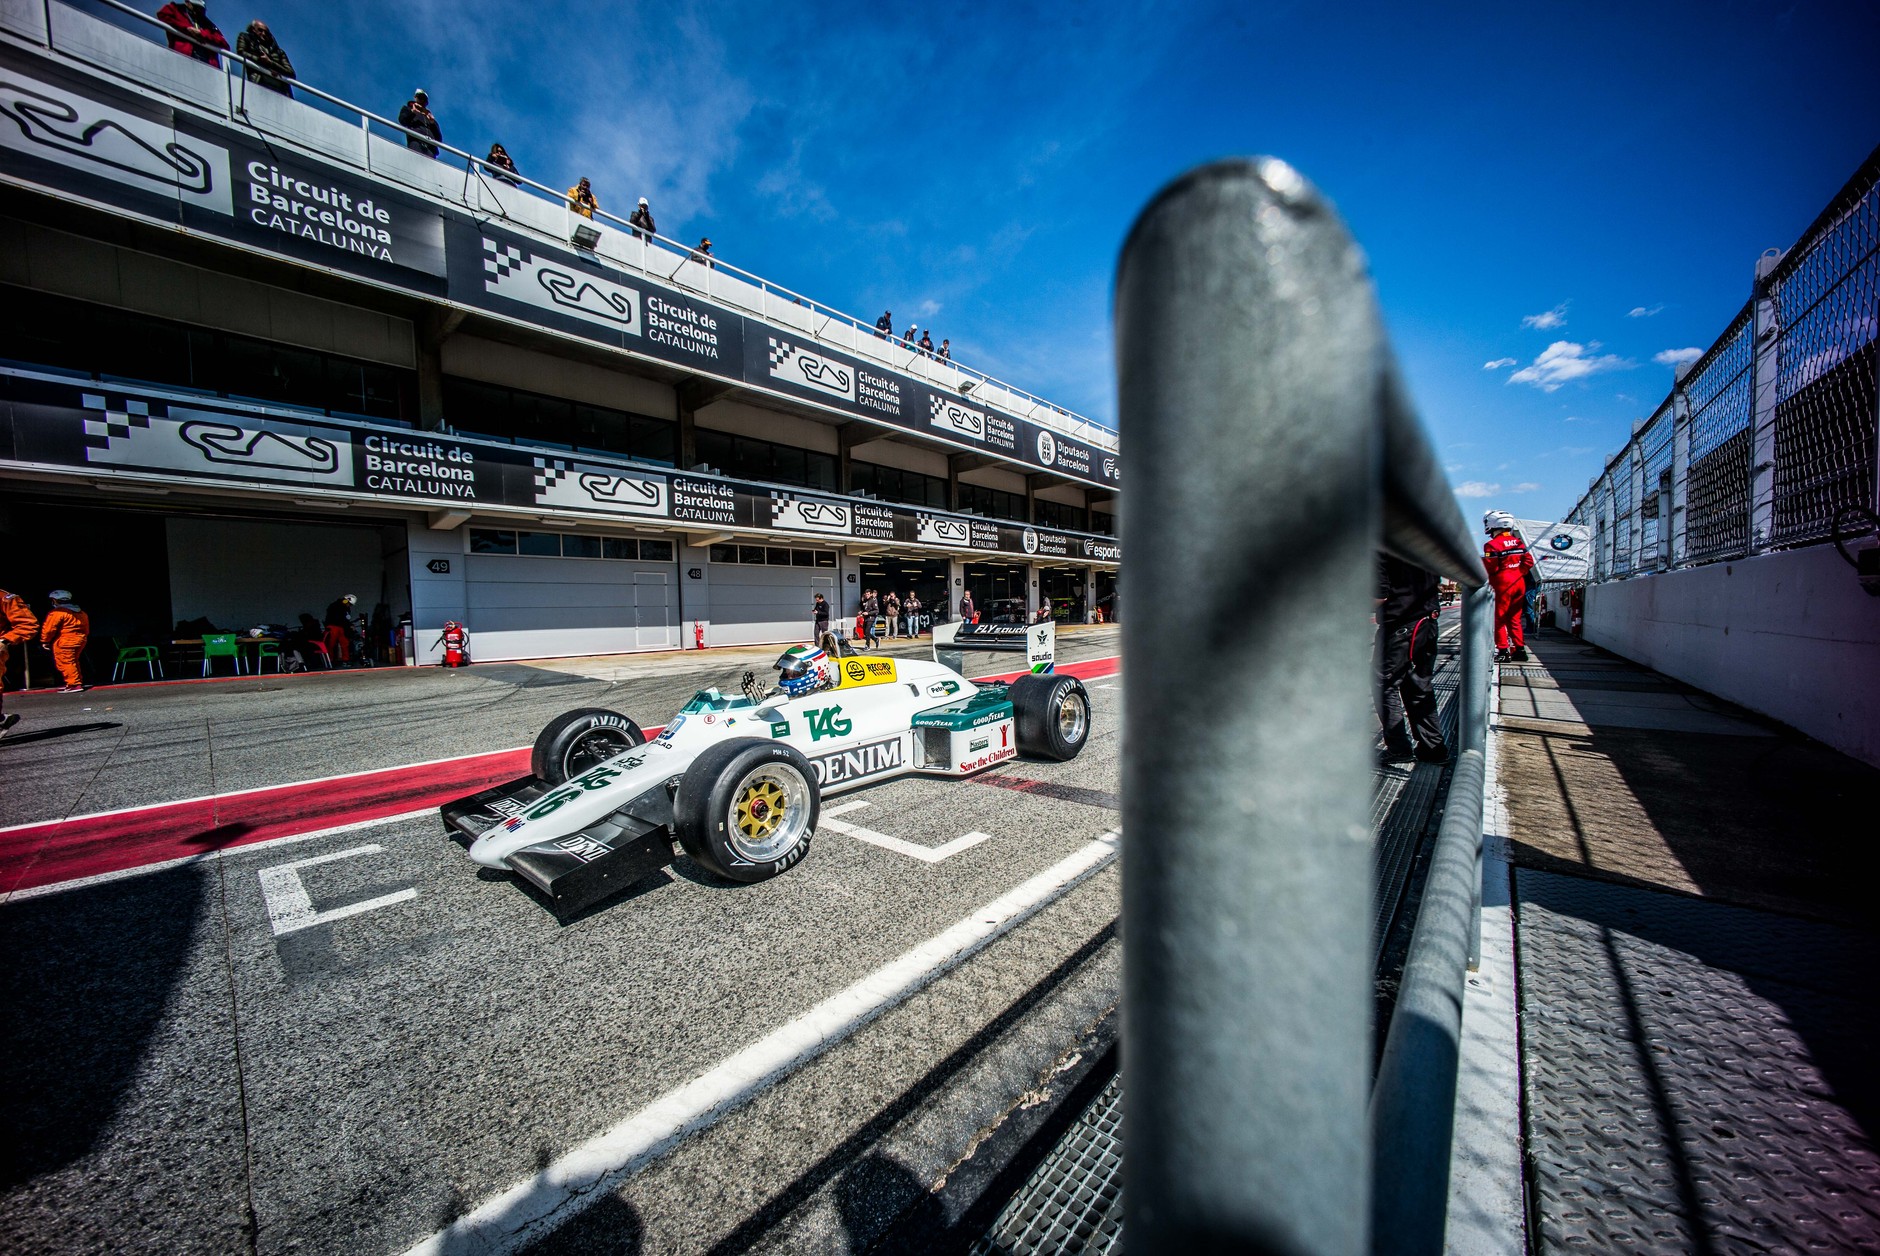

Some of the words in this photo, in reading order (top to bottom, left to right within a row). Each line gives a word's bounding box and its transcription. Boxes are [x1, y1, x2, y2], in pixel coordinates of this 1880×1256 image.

[247, 161, 352, 212] Circuit
[357, 200, 390, 224] de
[250, 182, 392, 245] Barcelona
[251, 208, 394, 263] CATALUNYA
[647, 296, 698, 324] Circuit
[700, 314, 717, 330] de
[648, 311, 718, 345] Barcelona
[649, 329, 719, 359] CATALUNYA
[858, 371, 889, 390] Circuit
[889, 381, 900, 393] de
[859, 382, 900, 405] Barcelona
[859, 395, 901, 415] CATALUNYA
[986, 415, 1007, 429] Circuit
[1006, 421, 1014, 432] de
[987, 425, 1015, 441] Barcelona
[364, 435, 445, 460] Circuit
[447, 446, 474, 464] de
[987, 435, 1015, 450] CATALUNYA
[1057, 441, 1090, 461] Diputació
[366, 454, 475, 481] Barcelona
[1057, 455, 1090, 473] Barcelona
[367, 475, 476, 498] CATALUNYA
[673, 478, 717, 495] Circuit
[718, 484, 734, 497] de
[674, 492, 735, 511] Barcelona
[674, 507, 735, 522] CATALUNYA
[854, 504, 882, 517] Circuit
[883, 507, 893, 518] de
[855, 515, 894, 529] Barcelona
[971, 521, 990, 531] Circuit
[990, 523, 998, 533] de
[855, 526, 894, 539] CATALUNYA
[972, 530, 999, 541] Barcelona
[1039, 532, 1067, 545] Diputació
[971, 540, 999, 549] CATALUNYA
[1039, 543, 1067, 555] Barcelona
[431, 561, 448, 572] 49
[690, 569, 701, 578] 48
[974, 624, 1029, 634] FLYsaudi
[866, 662, 891, 673] RECORD
[590, 715, 630, 731] AVON
[803, 704, 852, 742] TAG
[915, 719, 954, 727] GOODYEAR
[972, 711, 1005, 726] GOODYEAR
[809, 740, 901, 785] DENIM
[960, 760, 977, 772] Save
[977, 756, 988, 766] the
[988, 747, 1015, 763] Children
[560, 836, 611, 860] DENI
[774, 827, 813, 874] AVON
